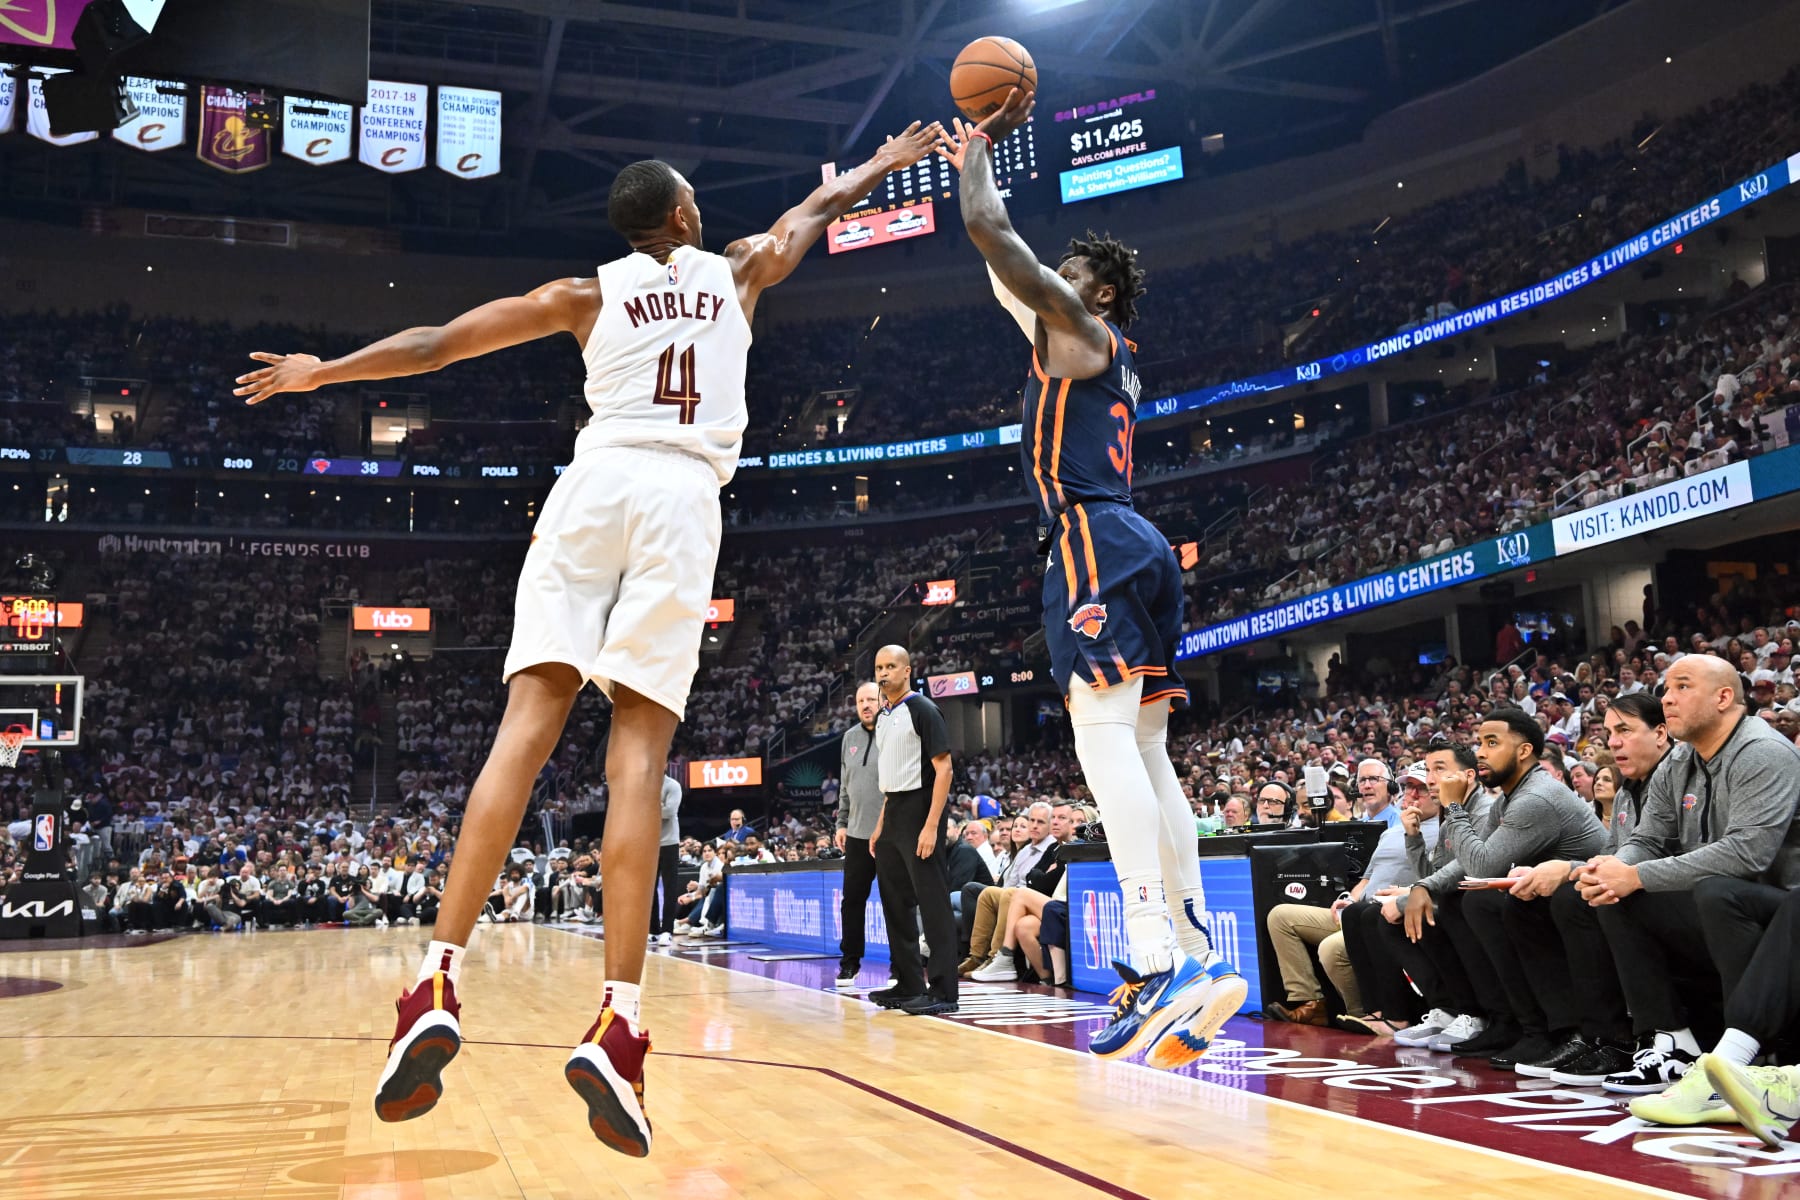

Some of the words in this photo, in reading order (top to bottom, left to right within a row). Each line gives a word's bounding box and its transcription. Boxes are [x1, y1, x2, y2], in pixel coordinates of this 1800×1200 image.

[127, 91, 183, 105] NFERENCE
[207, 94, 247, 110] CHAMPI
[370, 88, 417, 102] 2017-18
[440, 93, 469, 104] CENTRAL
[1097, 89, 1156, 110] RAFFLE
[136, 105, 180, 119] AMPIONS
[372, 103, 415, 117] EASTERN
[442, 102, 497, 117] CHAMPIONS
[291, 119, 346, 133] CHAMPIONS
[363, 115, 423, 131] CONFERENCE
[365, 129, 421, 143] CHAMPIONS
[1070, 119, 1143, 152] $11,425
[1071, 149, 1114, 166] CAVS.COM
[1071, 168, 1113, 185] Painting
[1114, 154, 1170, 176] Questions?
[1068, 186, 1086, 198] Ask
[1739, 173, 1768, 202] K&D
[860, 206, 883, 217] TOTALS
[1366, 333, 1411, 361] ICONIC
[1413, 302, 1497, 346] DOWNTOWN
[1500, 266, 1589, 312] RESIDENCES
[1591, 260, 1602, 277] &
[1604, 236, 1649, 271] LIVING
[1651, 198, 1721, 246] CENTERS
[623, 291, 725, 329] MOBLEY
[1296, 362, 1321, 381] K&D
[653, 342, 701, 424] 4
[963, 431, 984, 447] K&D
[0, 448, 30, 460] FG%
[123, 452, 142, 466] 28
[769, 450, 821, 468] DENCES
[825, 450, 835, 464] &
[838, 446, 884, 463] LIVING
[887, 438, 947, 458] CENTERS
[223, 457, 253, 469] 8:00
[361, 461, 379, 475] 38
[413, 465, 440, 476] FG%
[482, 466, 518, 477] FOULS
[1569, 511, 1615, 543] VISIT:
[1620, 475, 1729, 528] KANDD.COM
[1496, 532, 1530, 565] K&D
[14, 599, 48, 615] 8:00
[1186, 619, 1249, 654] DOWNTOWN
[1251, 594, 1330, 637] RESIDENCES
[1332, 592, 1343, 612] &
[1346, 575, 1395, 609] LIVING
[1399, 551, 1475, 594] CENTERS
[18, 615, 42, 639] 10
[372, 609, 413, 629] fubo
[13, 643, 50, 652] TISSOT
[955, 677, 969, 690] 28
[1011, 670, 1033, 682] 8:00
[702, 761, 748, 786] fubo
